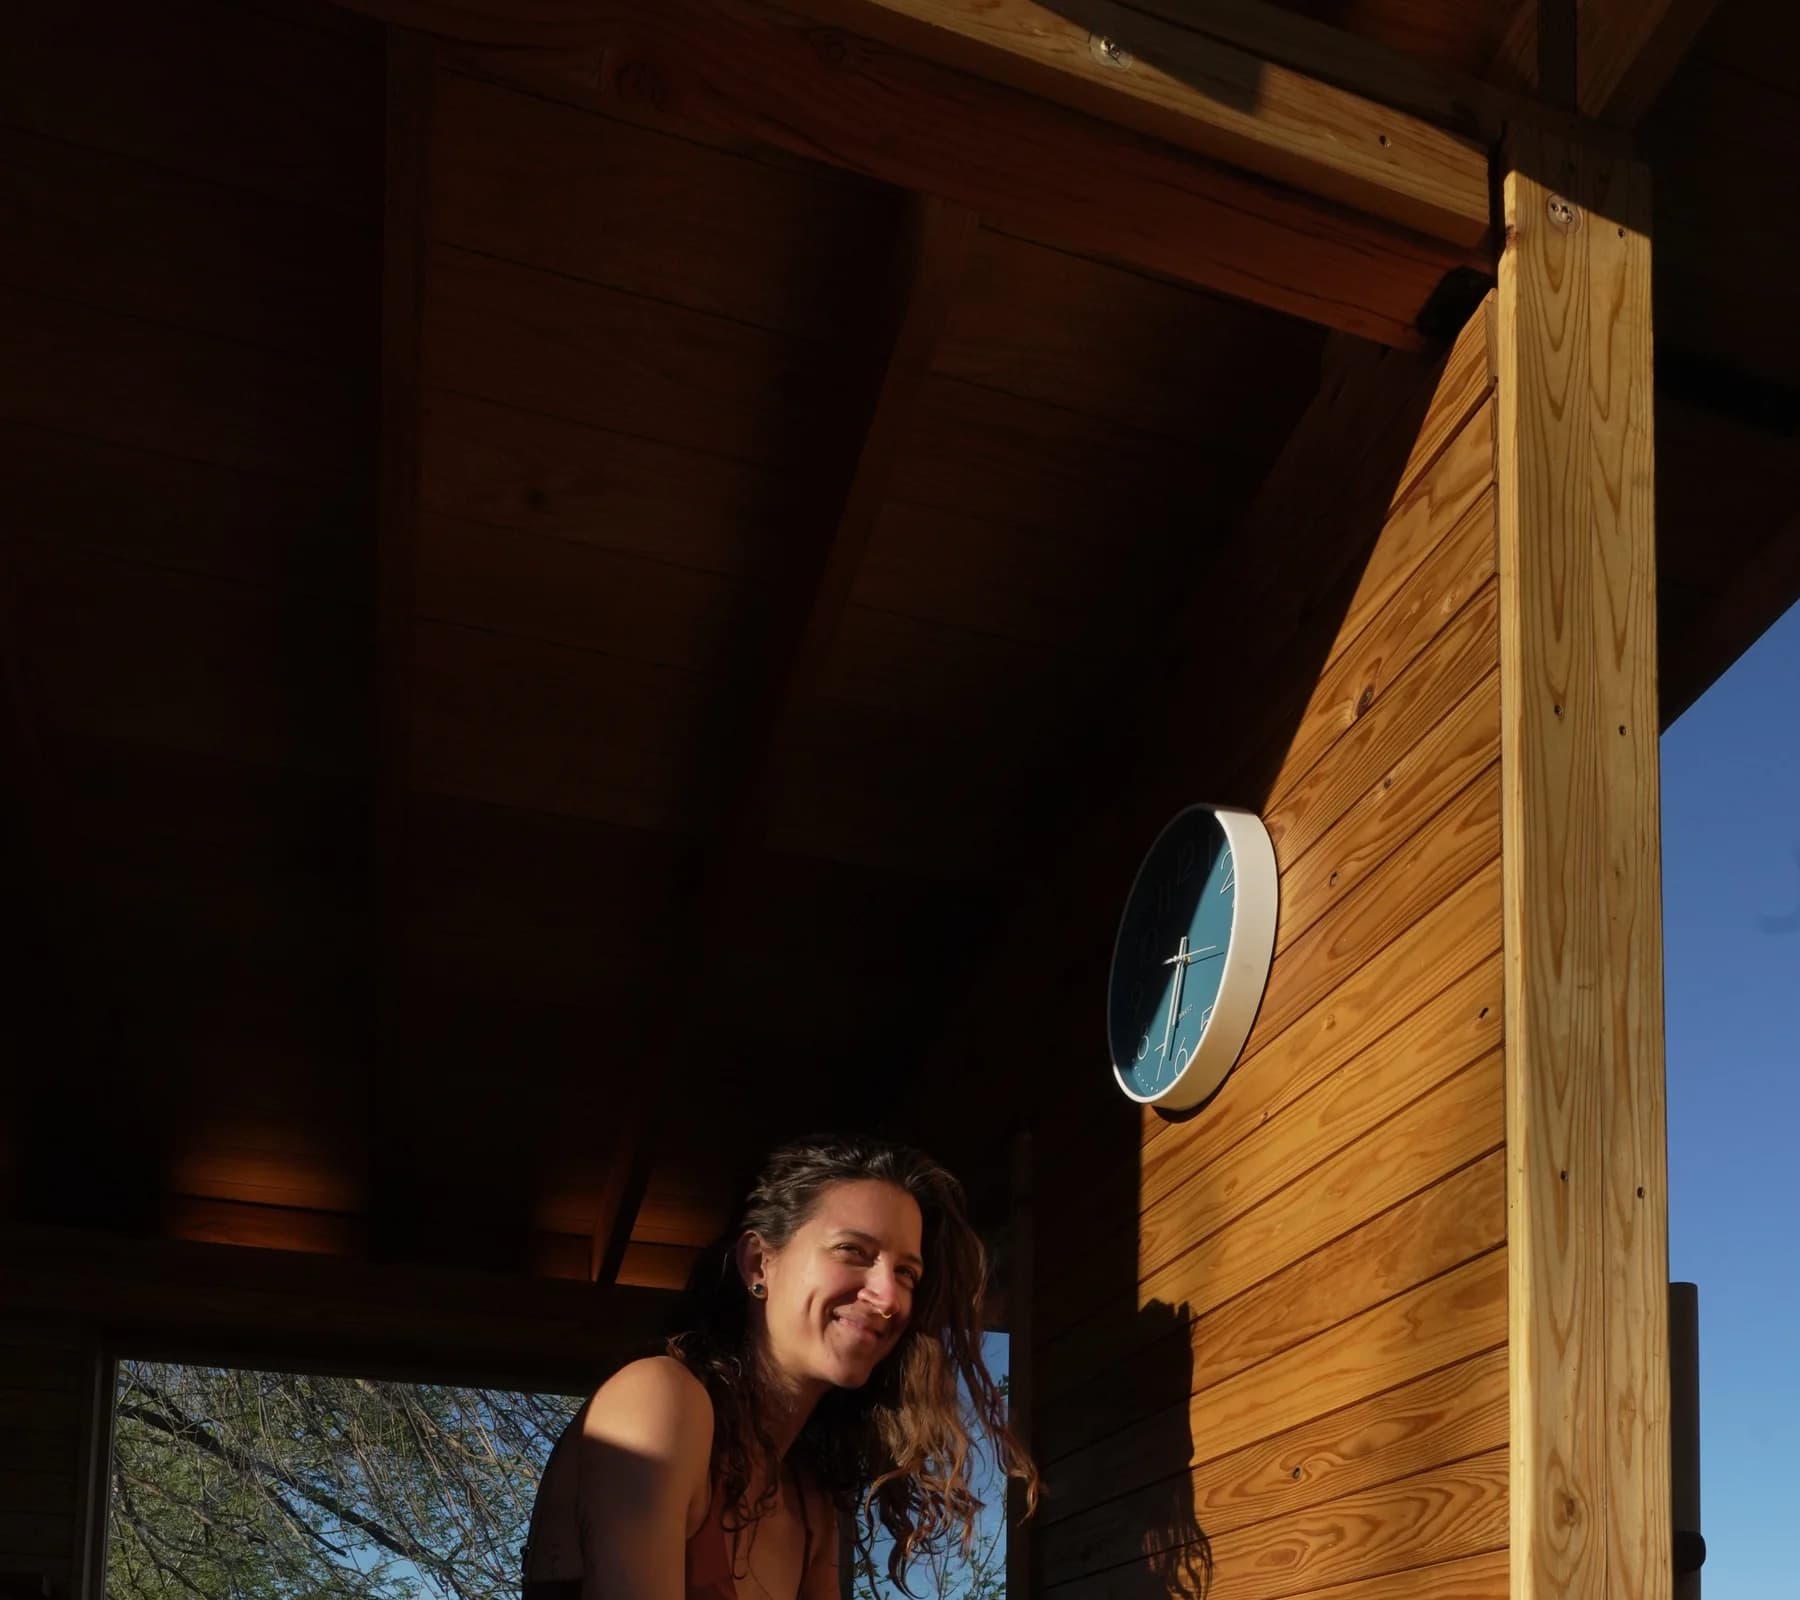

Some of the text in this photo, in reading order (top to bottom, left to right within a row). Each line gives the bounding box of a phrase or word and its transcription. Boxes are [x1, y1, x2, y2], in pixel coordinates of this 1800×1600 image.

[1219, 849, 1235, 895] 2
[1200, 1005, 1213, 1032] 5
[1154, 1042, 1167, 1081] 7
[1174, 1036, 1188, 1077] 6
